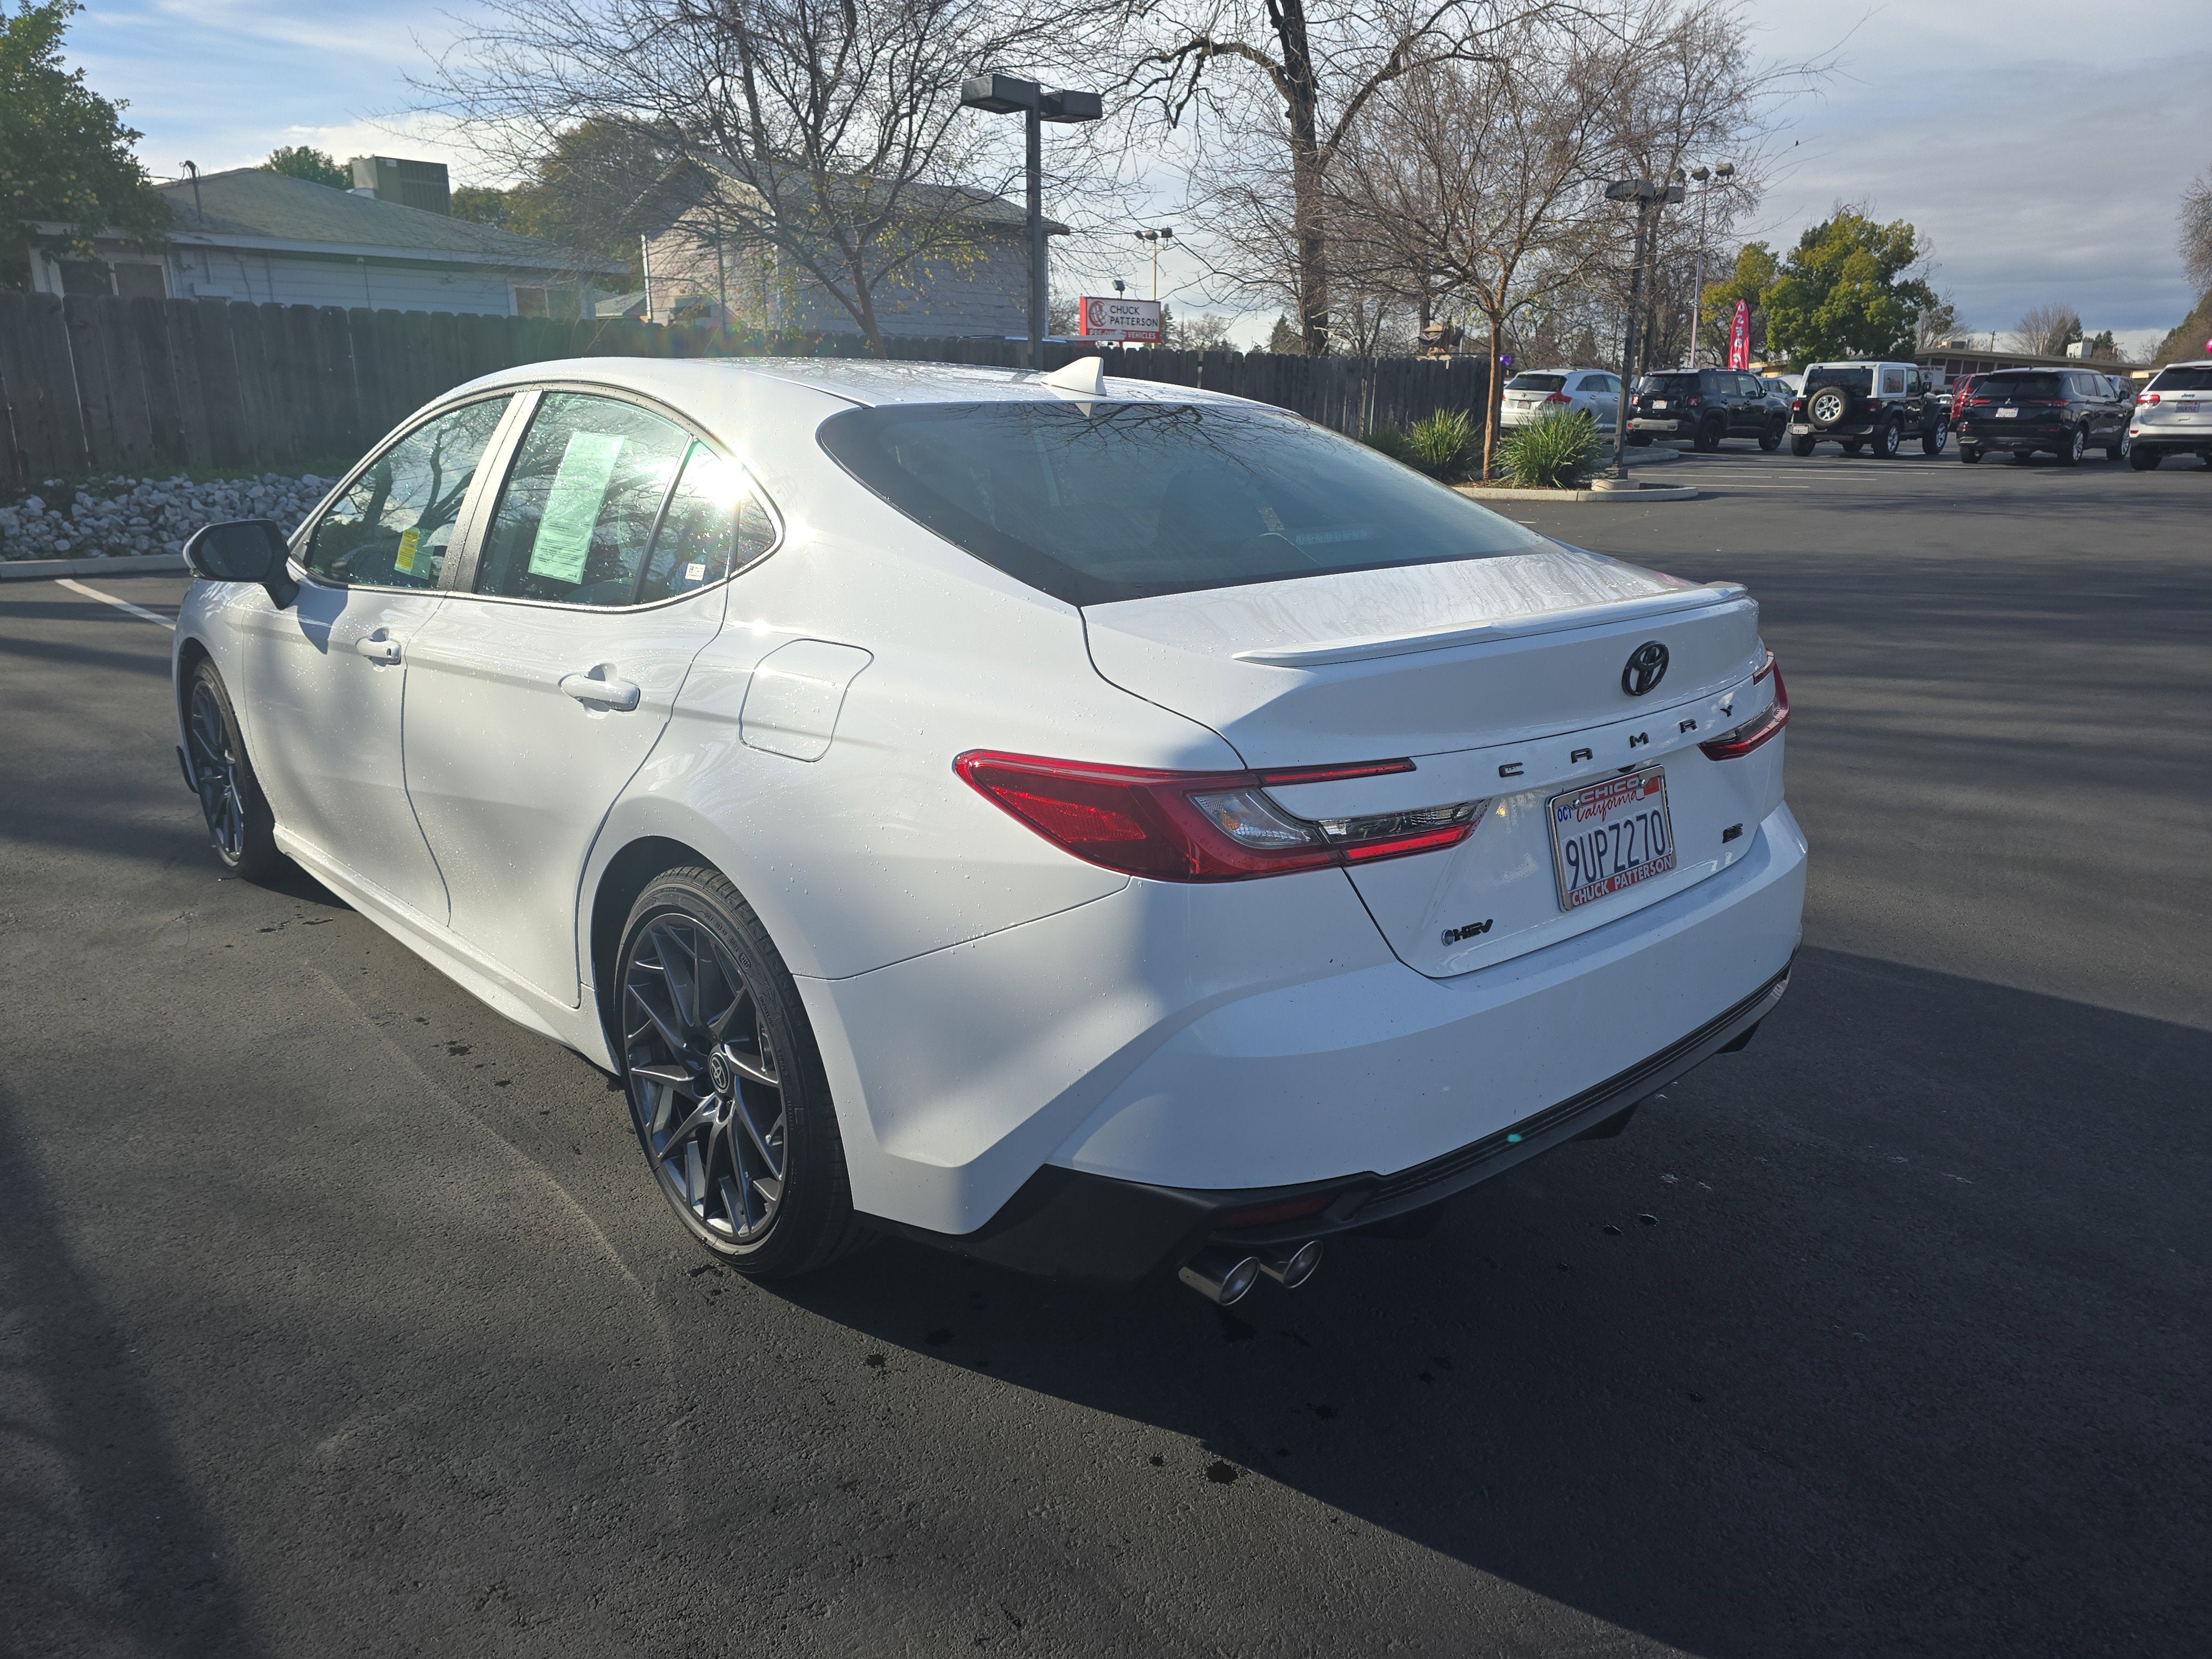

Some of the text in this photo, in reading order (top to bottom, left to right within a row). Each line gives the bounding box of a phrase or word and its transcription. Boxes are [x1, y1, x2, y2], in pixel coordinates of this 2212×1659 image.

[1110, 305, 1140, 315] CHUCK
[1110, 316, 1158, 327] PATTERSON
[1128, 331, 1156, 339] VEHICLES
[1499, 704, 1734, 778] CAMRY
[1580, 776, 1640, 803] CHICO
[1557, 806, 1572, 823] OCT
[1577, 789, 1645, 823] California
[1565, 809, 1666, 891] 9UPZ270
[1572, 855, 1673, 907] CHUCK PATTERSON
